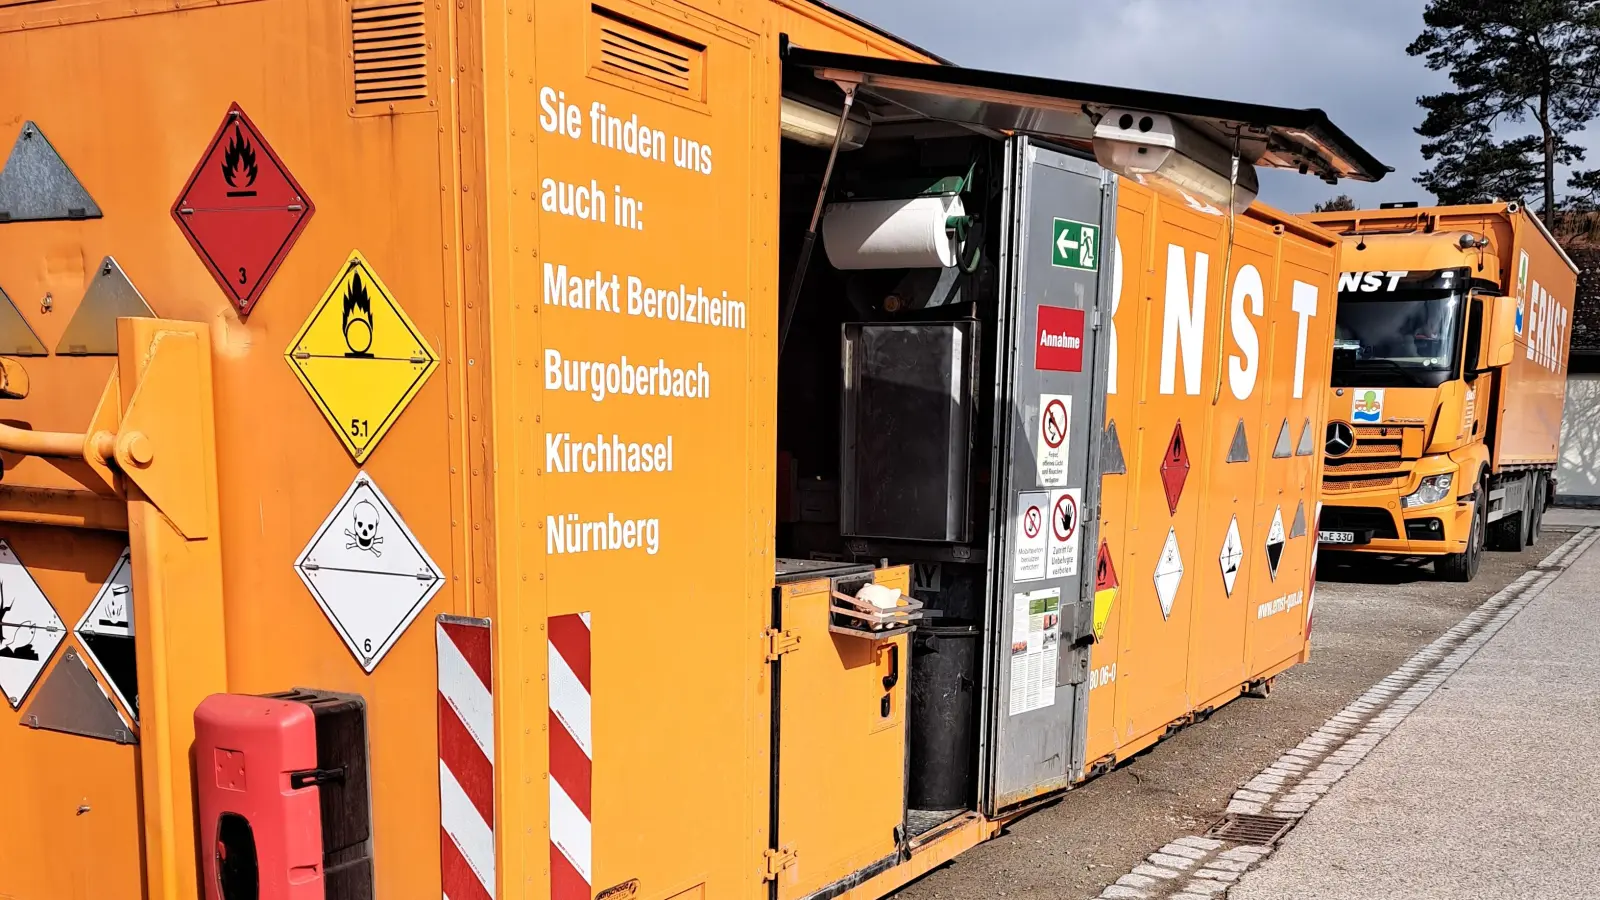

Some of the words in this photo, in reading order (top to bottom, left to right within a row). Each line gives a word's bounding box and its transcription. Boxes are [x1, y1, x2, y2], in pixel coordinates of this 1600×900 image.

[539, 86, 582, 139] Sie
[590, 101, 666, 162] finden
[673, 135, 712, 175] uns
[541, 177, 606, 223] auch
[614, 184, 643, 231] in:
[238, 267, 247, 285] 3
[543, 262, 621, 314] Markt
[627, 275, 746, 329] Berolzheim
[1040, 329, 1080, 350] Annahme
[1526, 279, 1568, 375] ERNST
[544, 348, 710, 402] Burgoberbach
[350, 418, 370, 438] 5.1
[545, 432, 673, 473] Kirchhasel
[546, 512, 660, 555] Nürnberg
[1329, 532, 1335, 541] E
[1336, 532, 1353, 542] 330
[363, 638, 372, 653] 6
